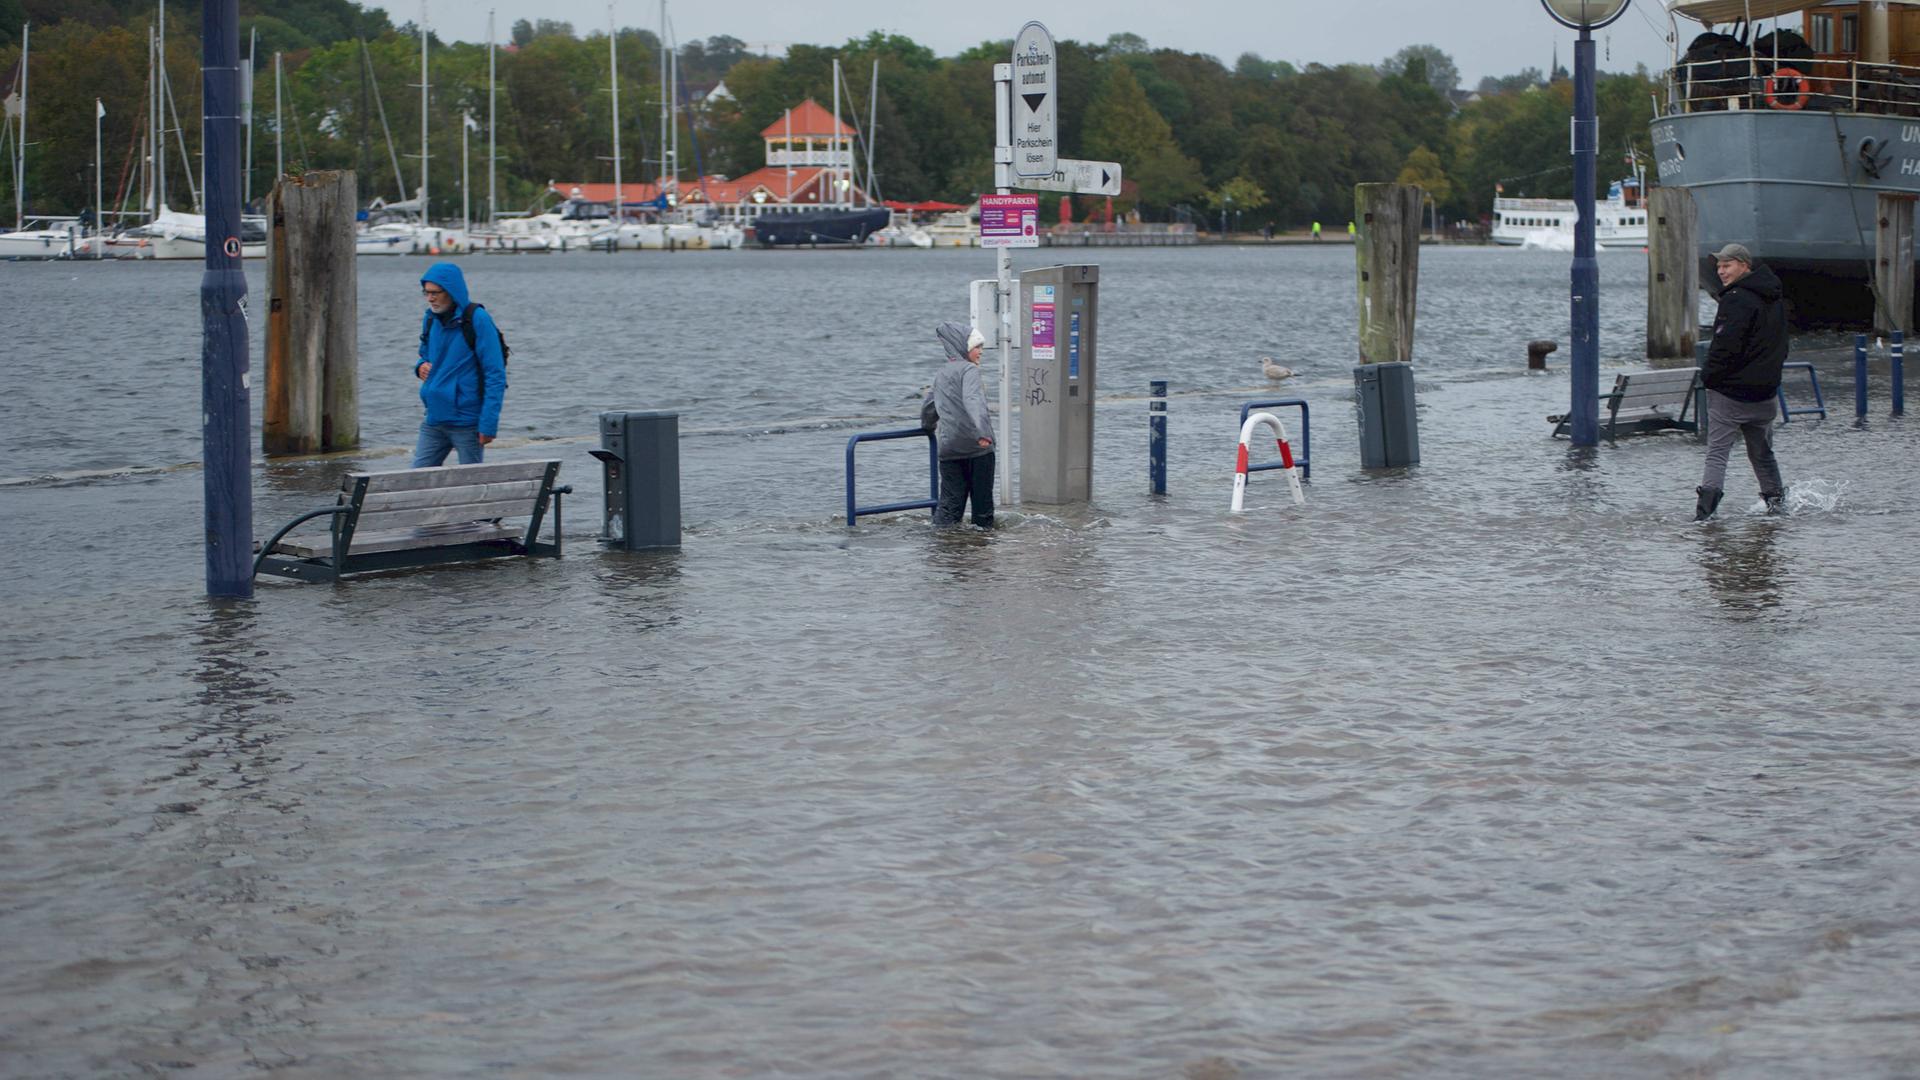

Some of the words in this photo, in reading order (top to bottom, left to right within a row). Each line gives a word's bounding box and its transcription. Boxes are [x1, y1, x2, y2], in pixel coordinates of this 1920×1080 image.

[1016, 53, 1052, 66] Parkschein-
[1022, 71, 1046, 84] automat
[1027, 122, 1042, 133] Hier
[1016, 137, 1053, 149] Parkschein
[1026, 152, 1044, 164] lösen
[982, 197, 1037, 206] HANDYPARKEN
